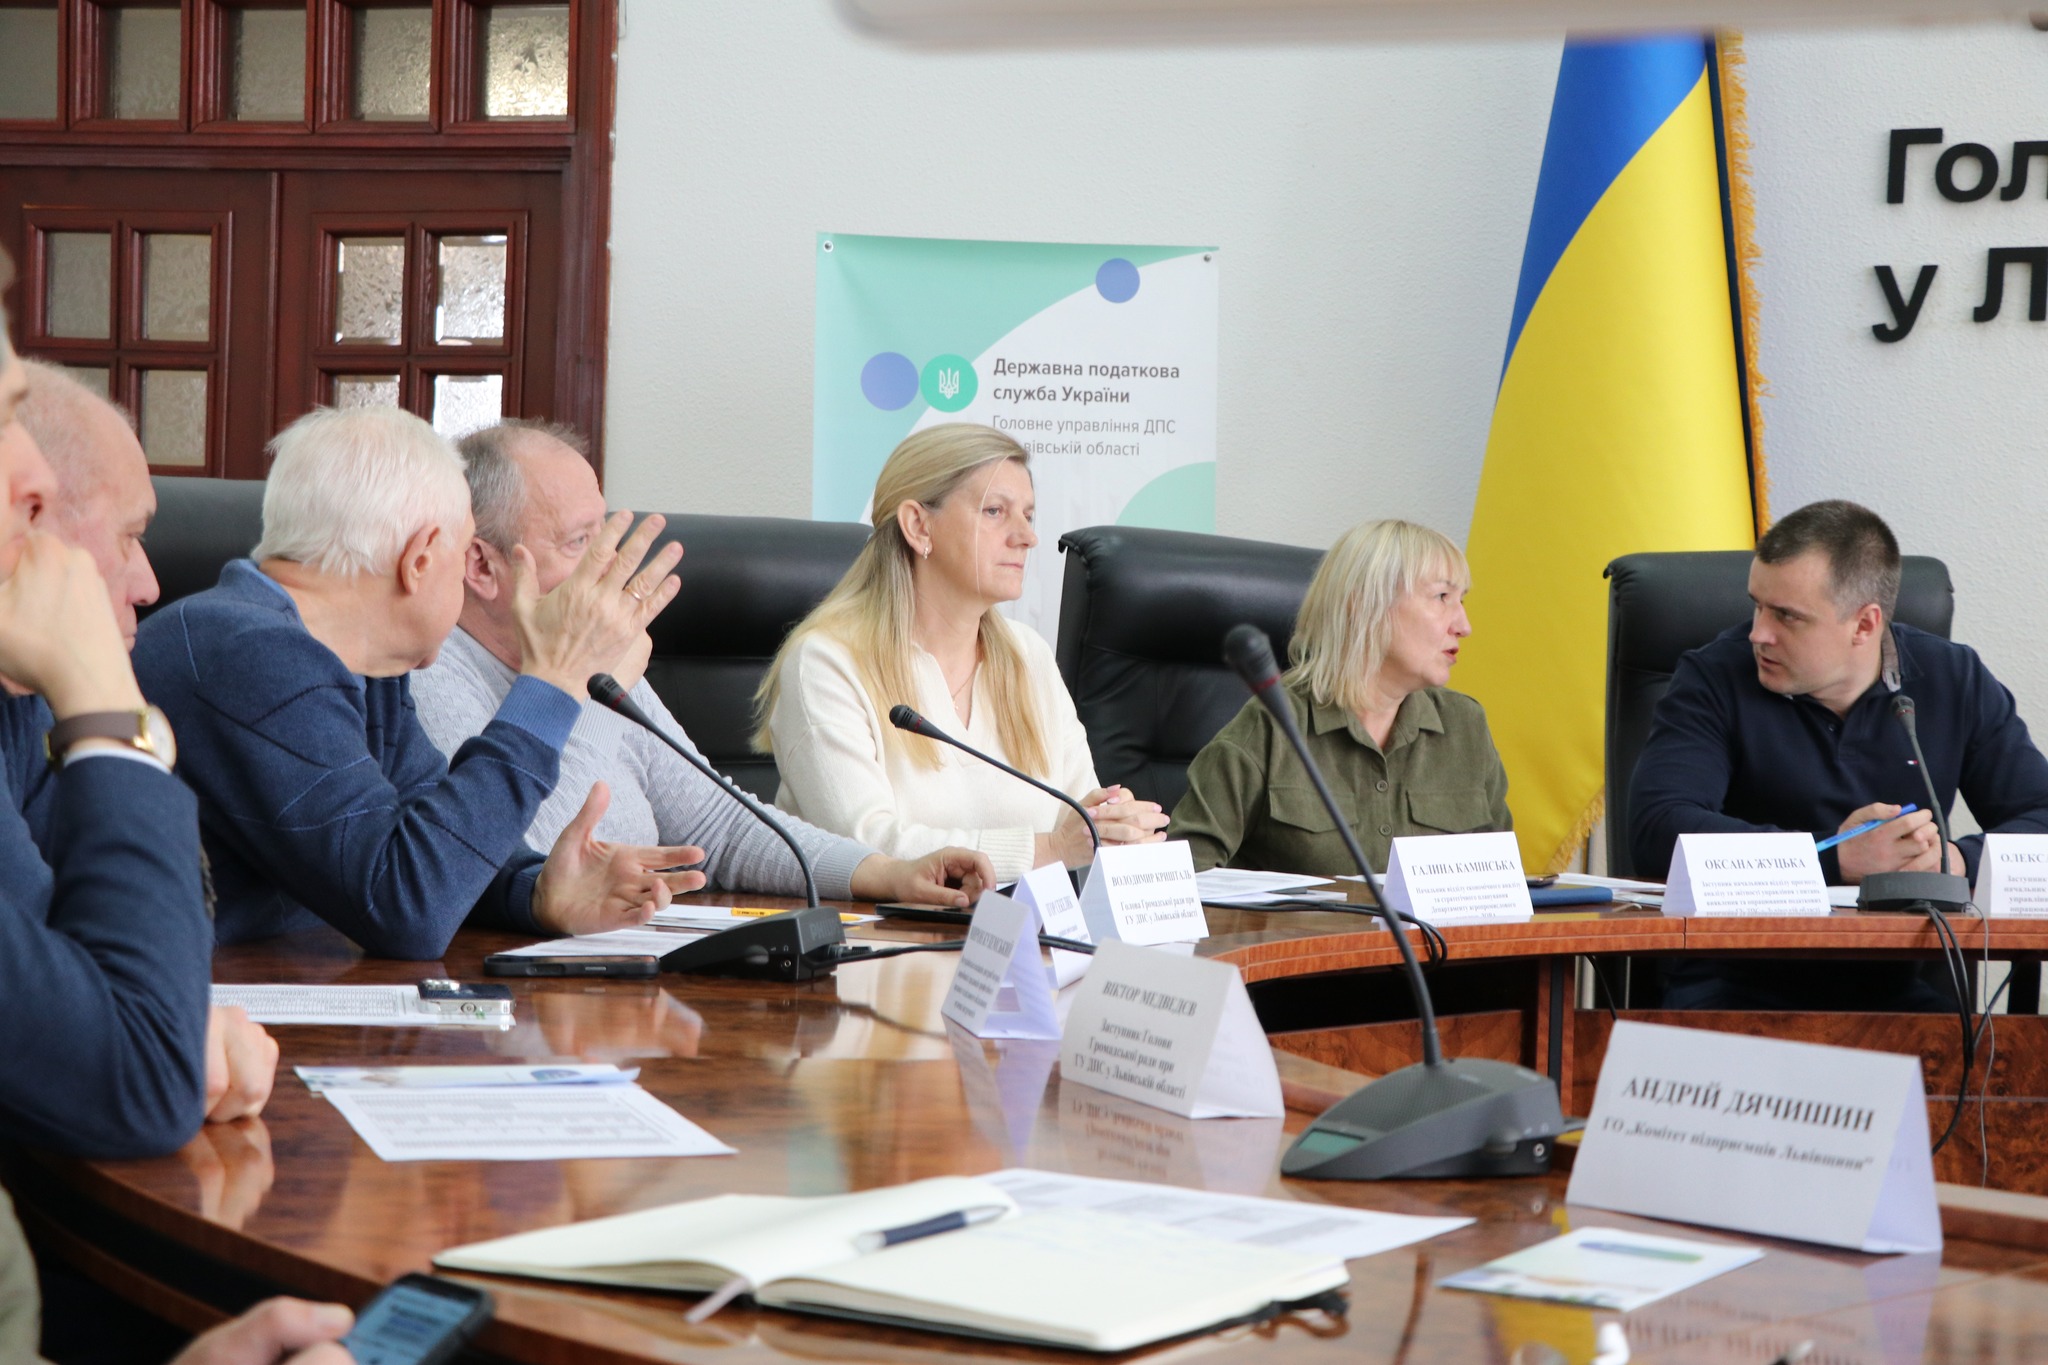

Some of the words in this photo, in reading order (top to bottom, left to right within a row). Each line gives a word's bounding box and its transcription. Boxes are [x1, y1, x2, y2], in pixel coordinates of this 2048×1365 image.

[1872, 264, 1939, 343] у
[993, 358, 1083, 377] Державна
[1088, 364, 1180, 379] податкова
[993, 386, 1057, 404] служба
[1062, 386, 1130, 405] України
[992, 415, 1053, 431] Головне
[1057, 418, 1139, 435] управління
[1144, 419, 1176, 435] ДПС
[1086, 441, 1140, 456] області
[1411, 864, 1454, 876] ГАЛИНА
[1456, 860, 1515, 873] КАМІНСЬКА
[1705, 859, 1754, 870] ОКСАНА
[1755, 858, 1806, 870] ЖУЦЬКА
[2001, 853, 2048, 863] ОЛЕКС
[1111, 873, 1154, 887] ВОЛОДИМИР
[1155, 869, 1192, 882] КРИШТАЛЬ
[1125, 914, 1134, 925] ГУ
[1102, 981, 1141, 1002] ВІКТОР
[1140, 990, 1198, 1017] МЕДВЕДЄВ
[1100, 1018, 1140, 1041] Заступник
[1142, 1029, 1173, 1050] Голови
[1075, 1053, 1085, 1068] ГУ
[1087, 1058, 1106, 1075] ДПС
[1623, 1076, 1722, 1110] АНДРІЙ
[1723, 1090, 1875, 1132] ДЯЧИШИН
[1603, 1116, 1625, 1133] ГО
[1690, 1134, 1777, 1158] підприємців
